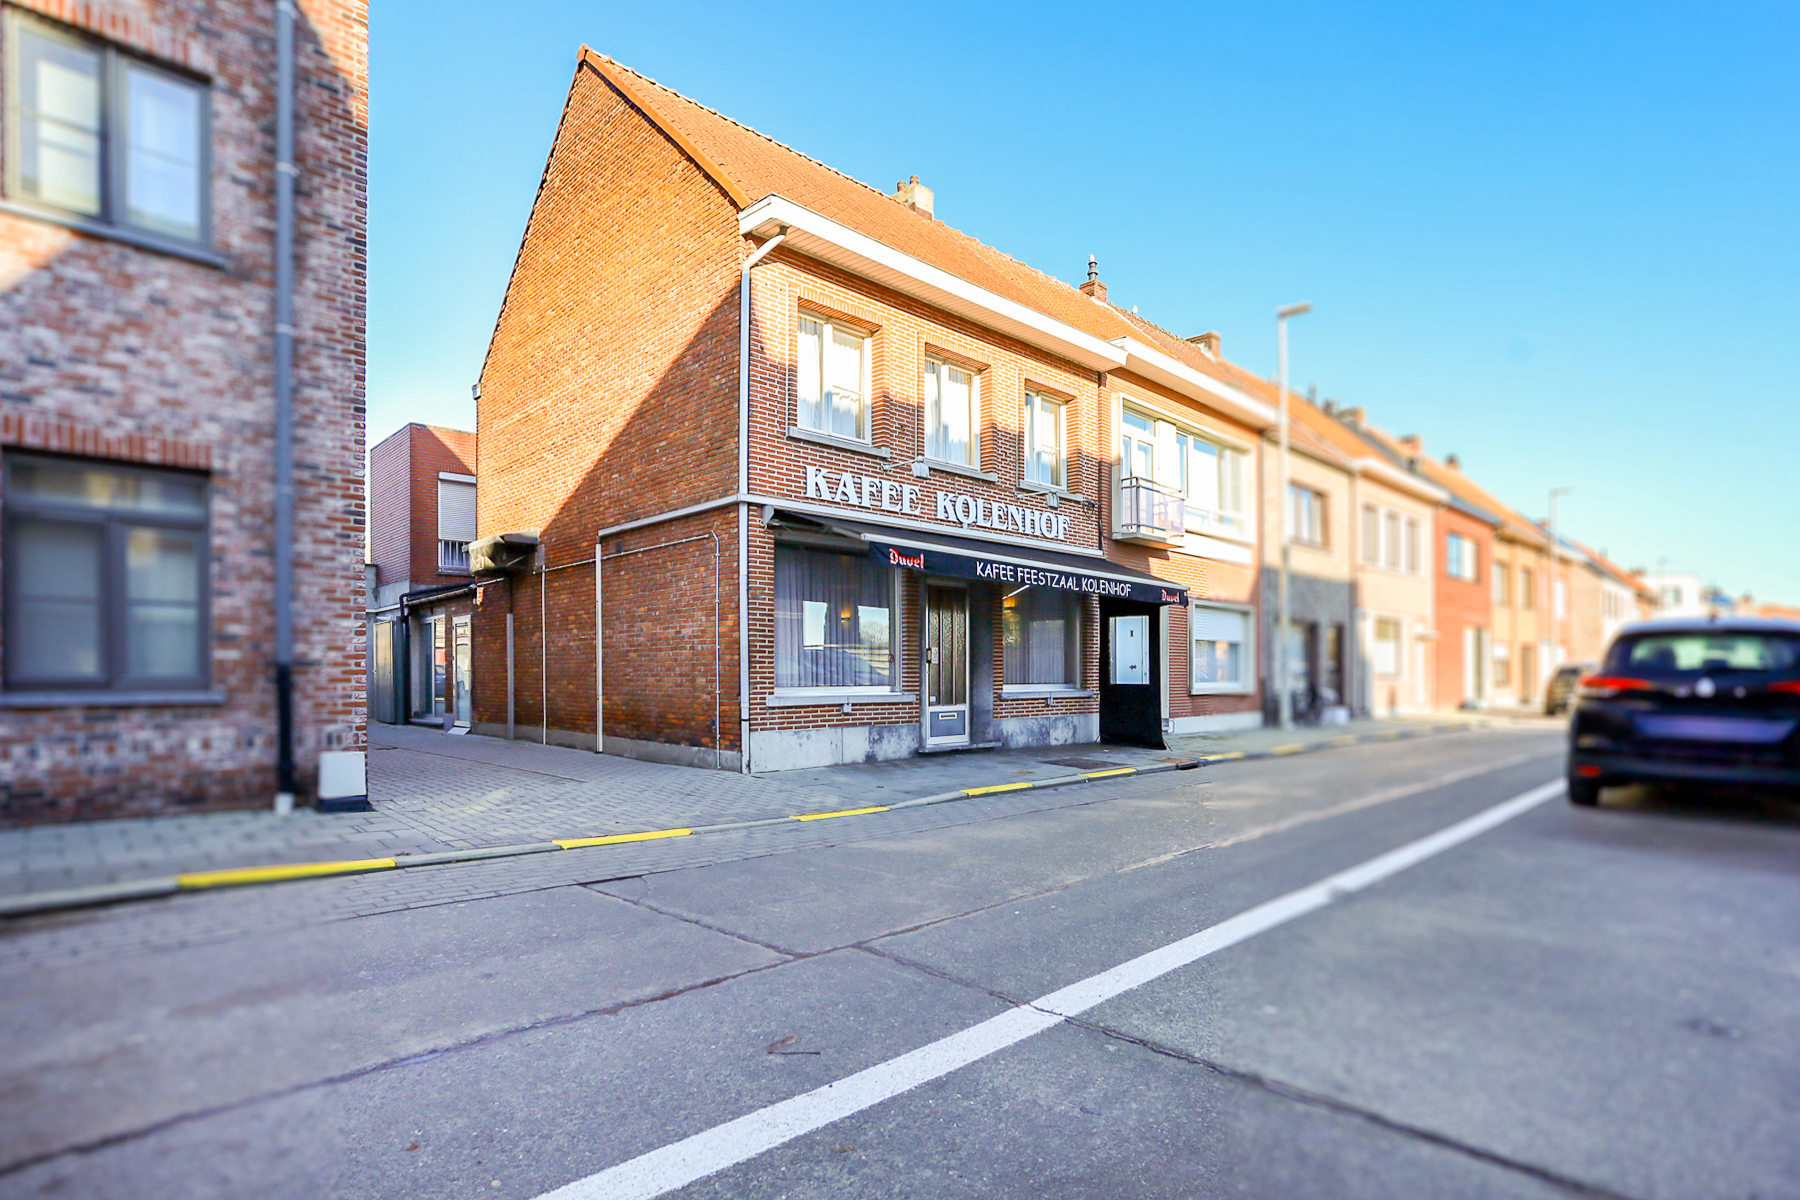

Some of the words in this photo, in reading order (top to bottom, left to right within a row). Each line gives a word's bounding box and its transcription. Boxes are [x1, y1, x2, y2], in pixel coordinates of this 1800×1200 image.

[804, 465, 921, 516] KAFEE
[936, 491, 1070, 540] KOLENHOF
[889, 547, 925, 569] Duvel
[976, 561, 1015, 582] KAFEE
[1017, 567, 1080, 591] FEESTZAAL
[1081, 577, 1132, 597] KOLENHOF
